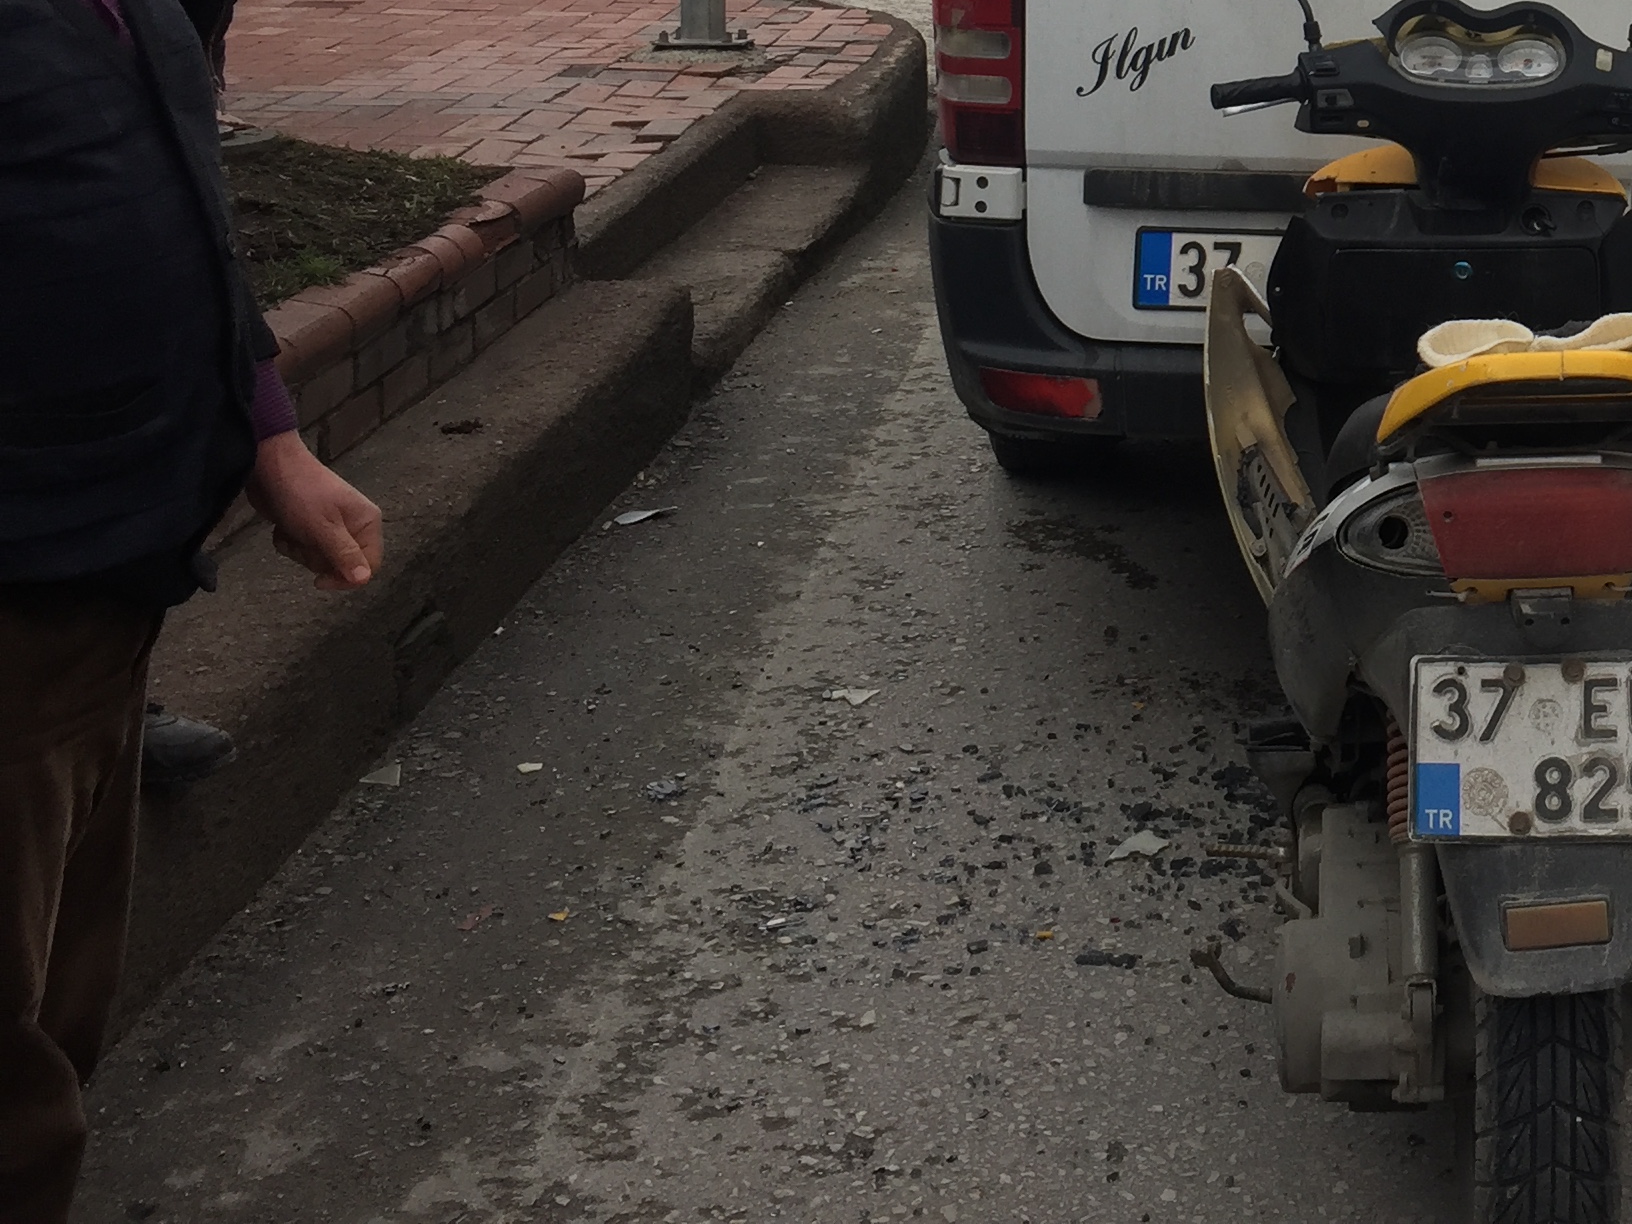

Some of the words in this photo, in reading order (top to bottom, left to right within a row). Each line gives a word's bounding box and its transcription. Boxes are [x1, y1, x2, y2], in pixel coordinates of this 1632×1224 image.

[1143, 274, 1168, 291] TR
[1431, 676, 1519, 743] 37
[1424, 808, 1453, 830] TR
